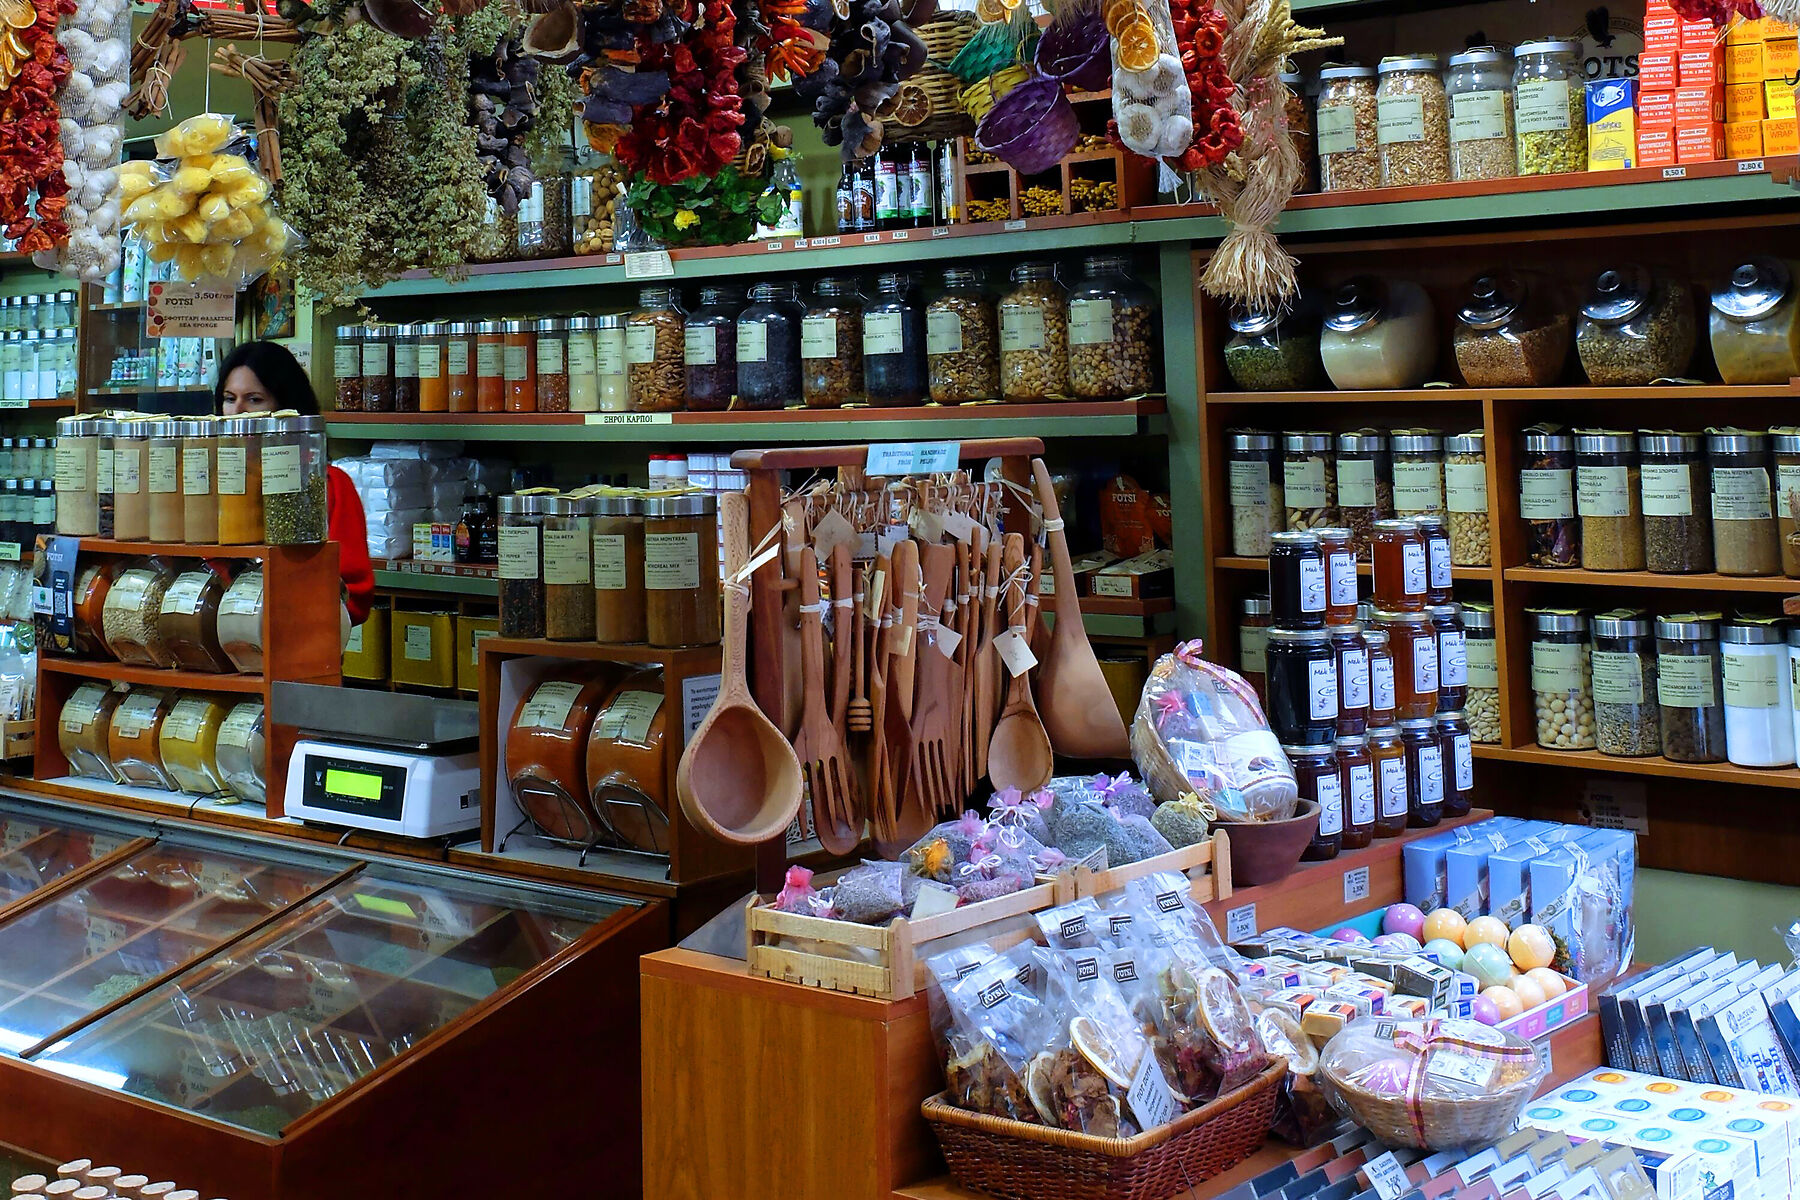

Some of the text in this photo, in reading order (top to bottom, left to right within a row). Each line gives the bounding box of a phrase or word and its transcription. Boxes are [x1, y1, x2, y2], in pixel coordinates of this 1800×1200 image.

[1583, 54, 1640, 79] OTS
[165, 297, 193, 306] FOTSI
[626, 415, 653, 423] ΚΑΡΠΟΙ
[1112, 493, 1137, 503] FOTSI
[1065, 922, 1085, 935] FOTSI
[1079, 965, 1095, 975] FOTSI
[1116, 968, 1132, 978] FOTSI
[984, 988, 1004, 1003] FOTSI
